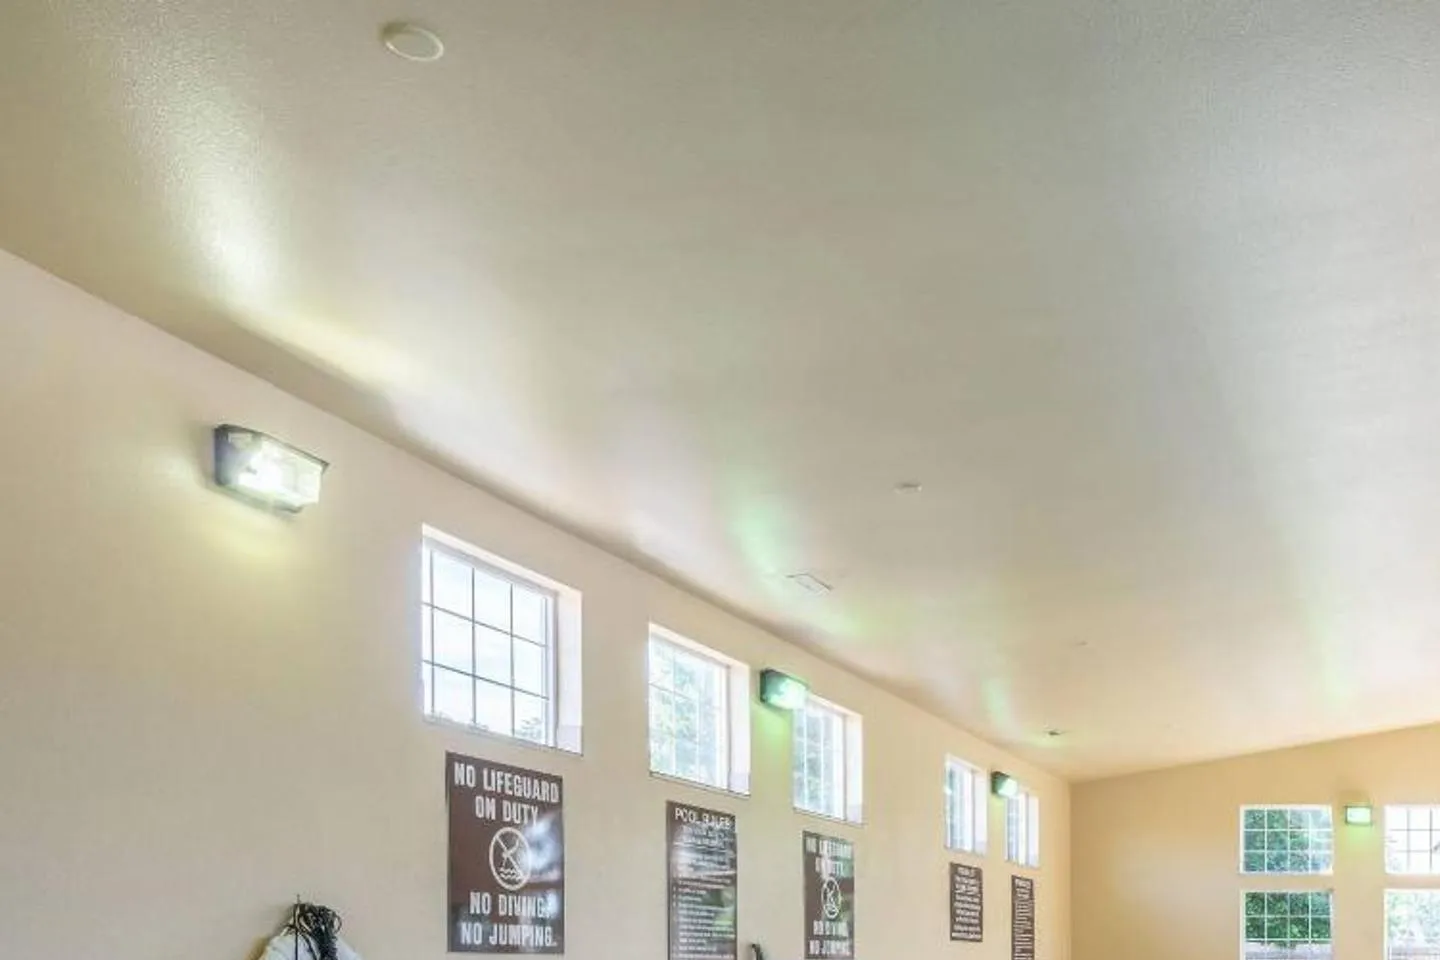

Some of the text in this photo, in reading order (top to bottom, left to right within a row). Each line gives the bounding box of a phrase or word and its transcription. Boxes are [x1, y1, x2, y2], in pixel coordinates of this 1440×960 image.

[454, 761, 560, 803] NO LIFEGUARD
[475, 795, 539, 826] ON DUTY
[469, 891, 491, 915] NO
[460, 920, 483, 945] NO
